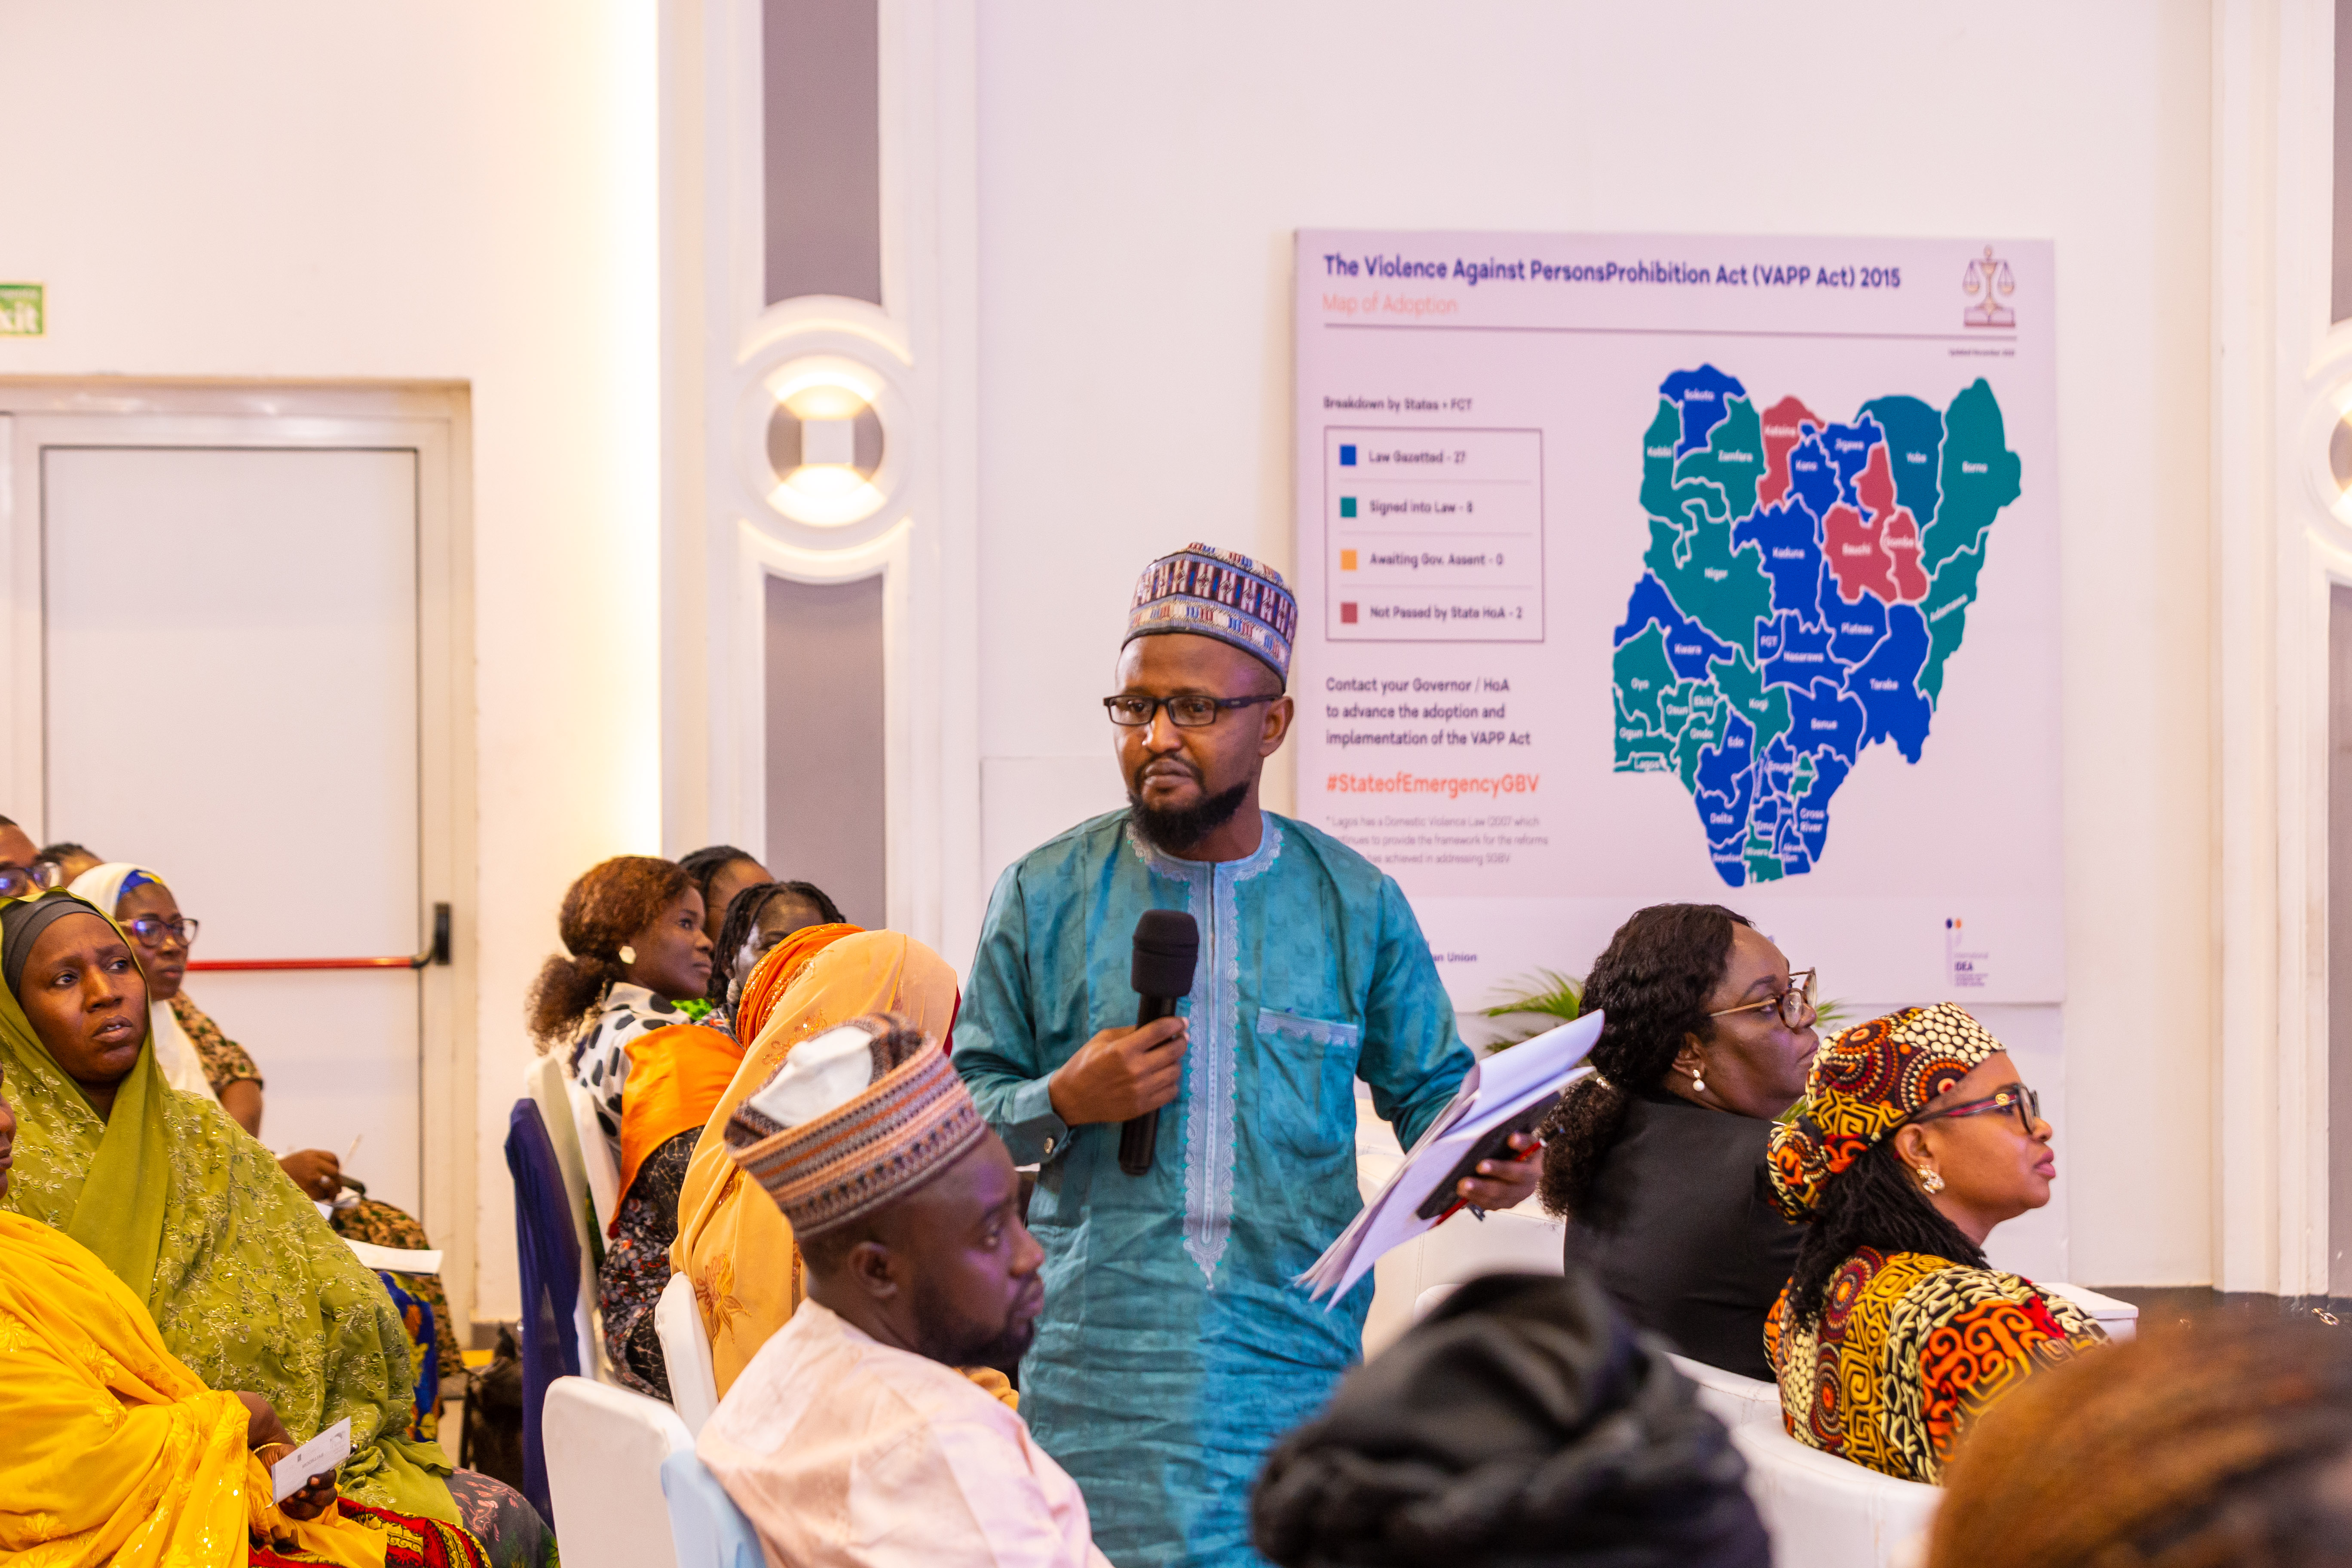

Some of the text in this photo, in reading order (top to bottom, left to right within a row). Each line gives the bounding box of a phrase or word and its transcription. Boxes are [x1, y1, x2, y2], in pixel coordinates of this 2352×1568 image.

[1324, 253, 1901, 288] The Violence Against PersonsProhibition Act (VAPP Act) 2015
[1322, 291, 1458, 317] Map of Adoption
[1323, 396, 1384, 410] Breakdown
[1387, 398, 1401, 413] by
[1404, 398, 1439, 411] States
[1450, 398, 1472, 411] FCT
[1369, 451, 1390, 463] Law
[1393, 450, 1444, 463] Gazetted
[1454, 450, 1467, 464] 27
[1369, 500, 1408, 517] Signed
[1410, 502, 1432, 514] into
[1435, 501, 1456, 514] Law
[1370, 553, 1419, 569] Awaiting
[1421, 553, 1444, 566] Gov.
[1448, 554, 1485, 566] Assent
[1370, 607, 1390, 618] Not
[1393, 606, 1432, 619] Passed
[1433, 606, 1448, 621] by
[1451, 606, 1480, 619] State
[1482, 607, 1506, 619] HoA
[1326, 677, 1378, 692] Contact
[1381, 681, 1409, 695] your
[1412, 677, 1472, 692] Governor
[1483, 679, 1510, 692] HoA
[1326, 704, 1506, 722] to advance the adoption and
[1326, 729, 1531, 748] implementation of the VAPP Act
[1326, 771, 1539, 799] #StateofEmergencyGBV
[1430, 816, 1466, 827] Violence
[1447, 952, 1477, 962] Union
